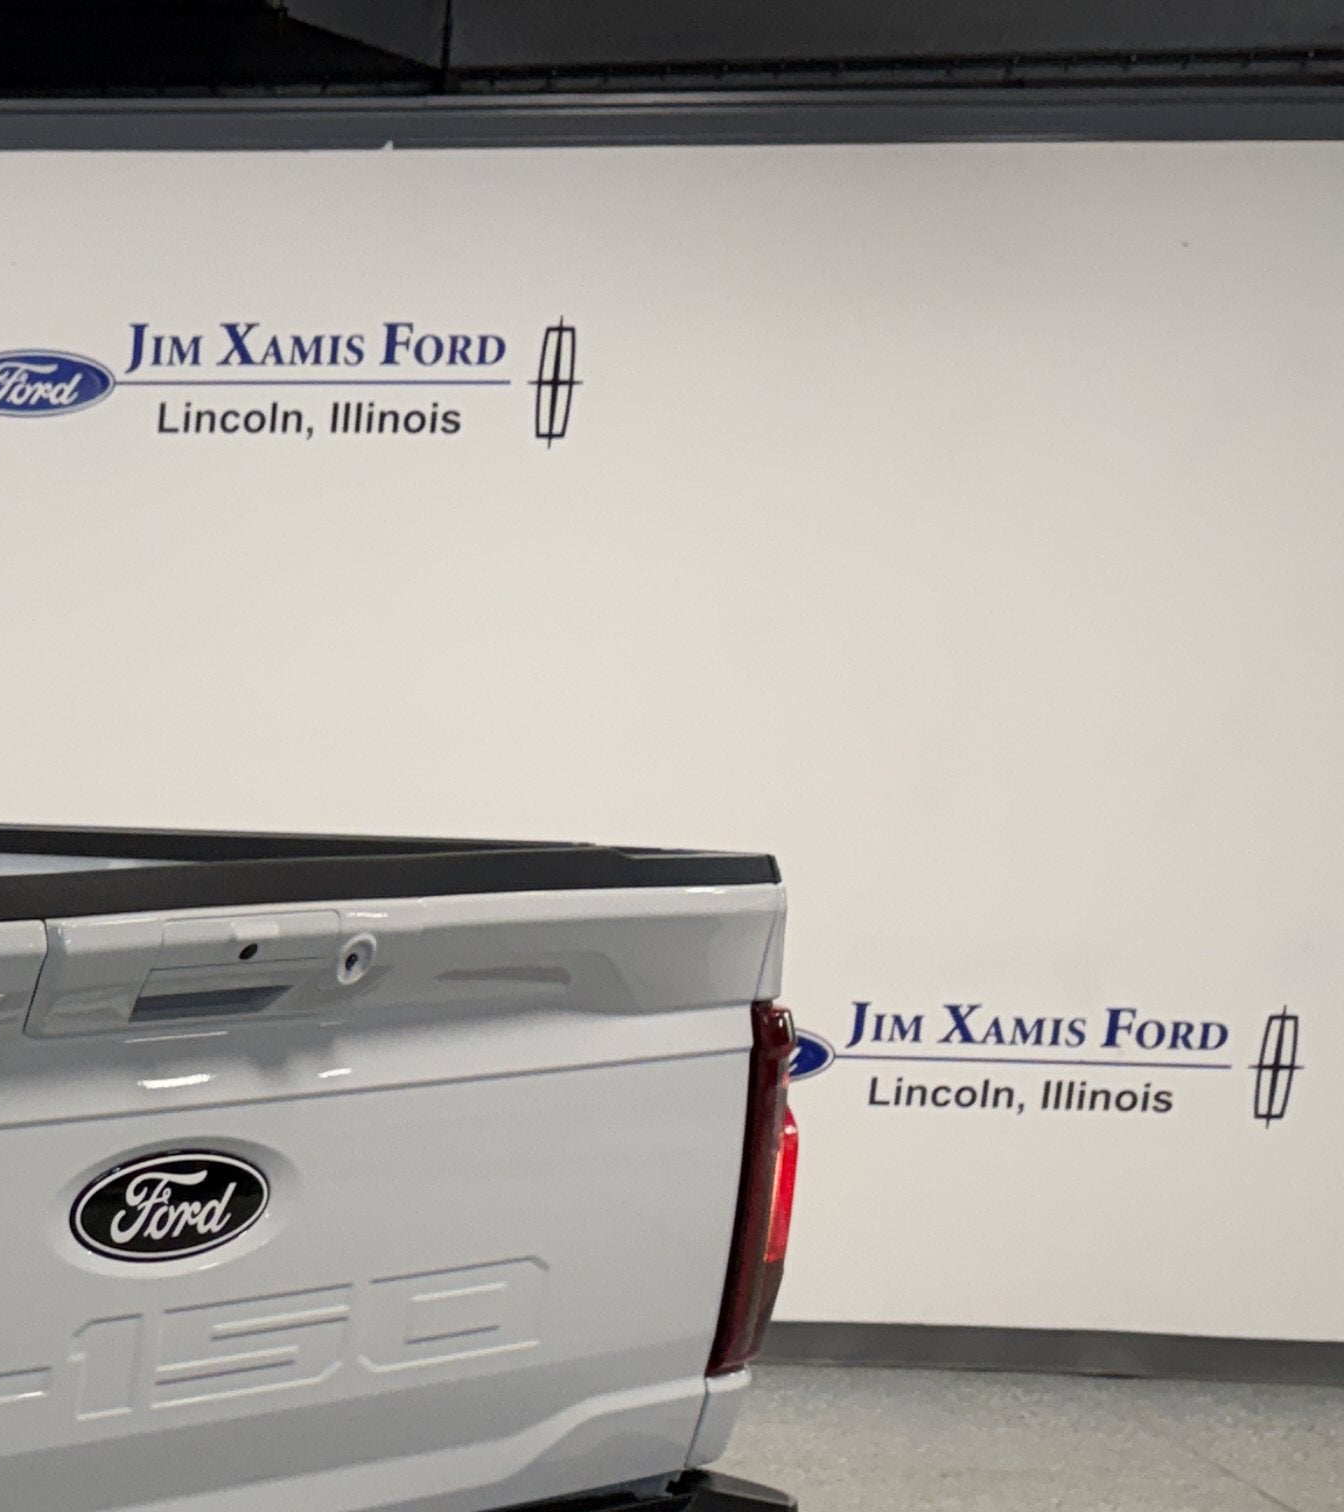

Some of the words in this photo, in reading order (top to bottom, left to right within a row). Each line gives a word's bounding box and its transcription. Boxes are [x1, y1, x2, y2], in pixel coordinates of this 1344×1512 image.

[124, 323, 202, 374] JIM
[217, 323, 365, 366] XAMIS
[379, 323, 506, 366] FORD
[156, 402, 314, 439] Lincoln,
[329, 403, 461, 434] Illinois
[846, 1001, 924, 1048] JIM
[937, 1004, 1086, 1048] XAMIS
[1101, 1007, 1229, 1051] FORD
[867, 1077, 1025, 1114] Lincoln,
[1040, 1081, 1174, 1113] Illinois
[110, 1170, 237, 1244] Ford
